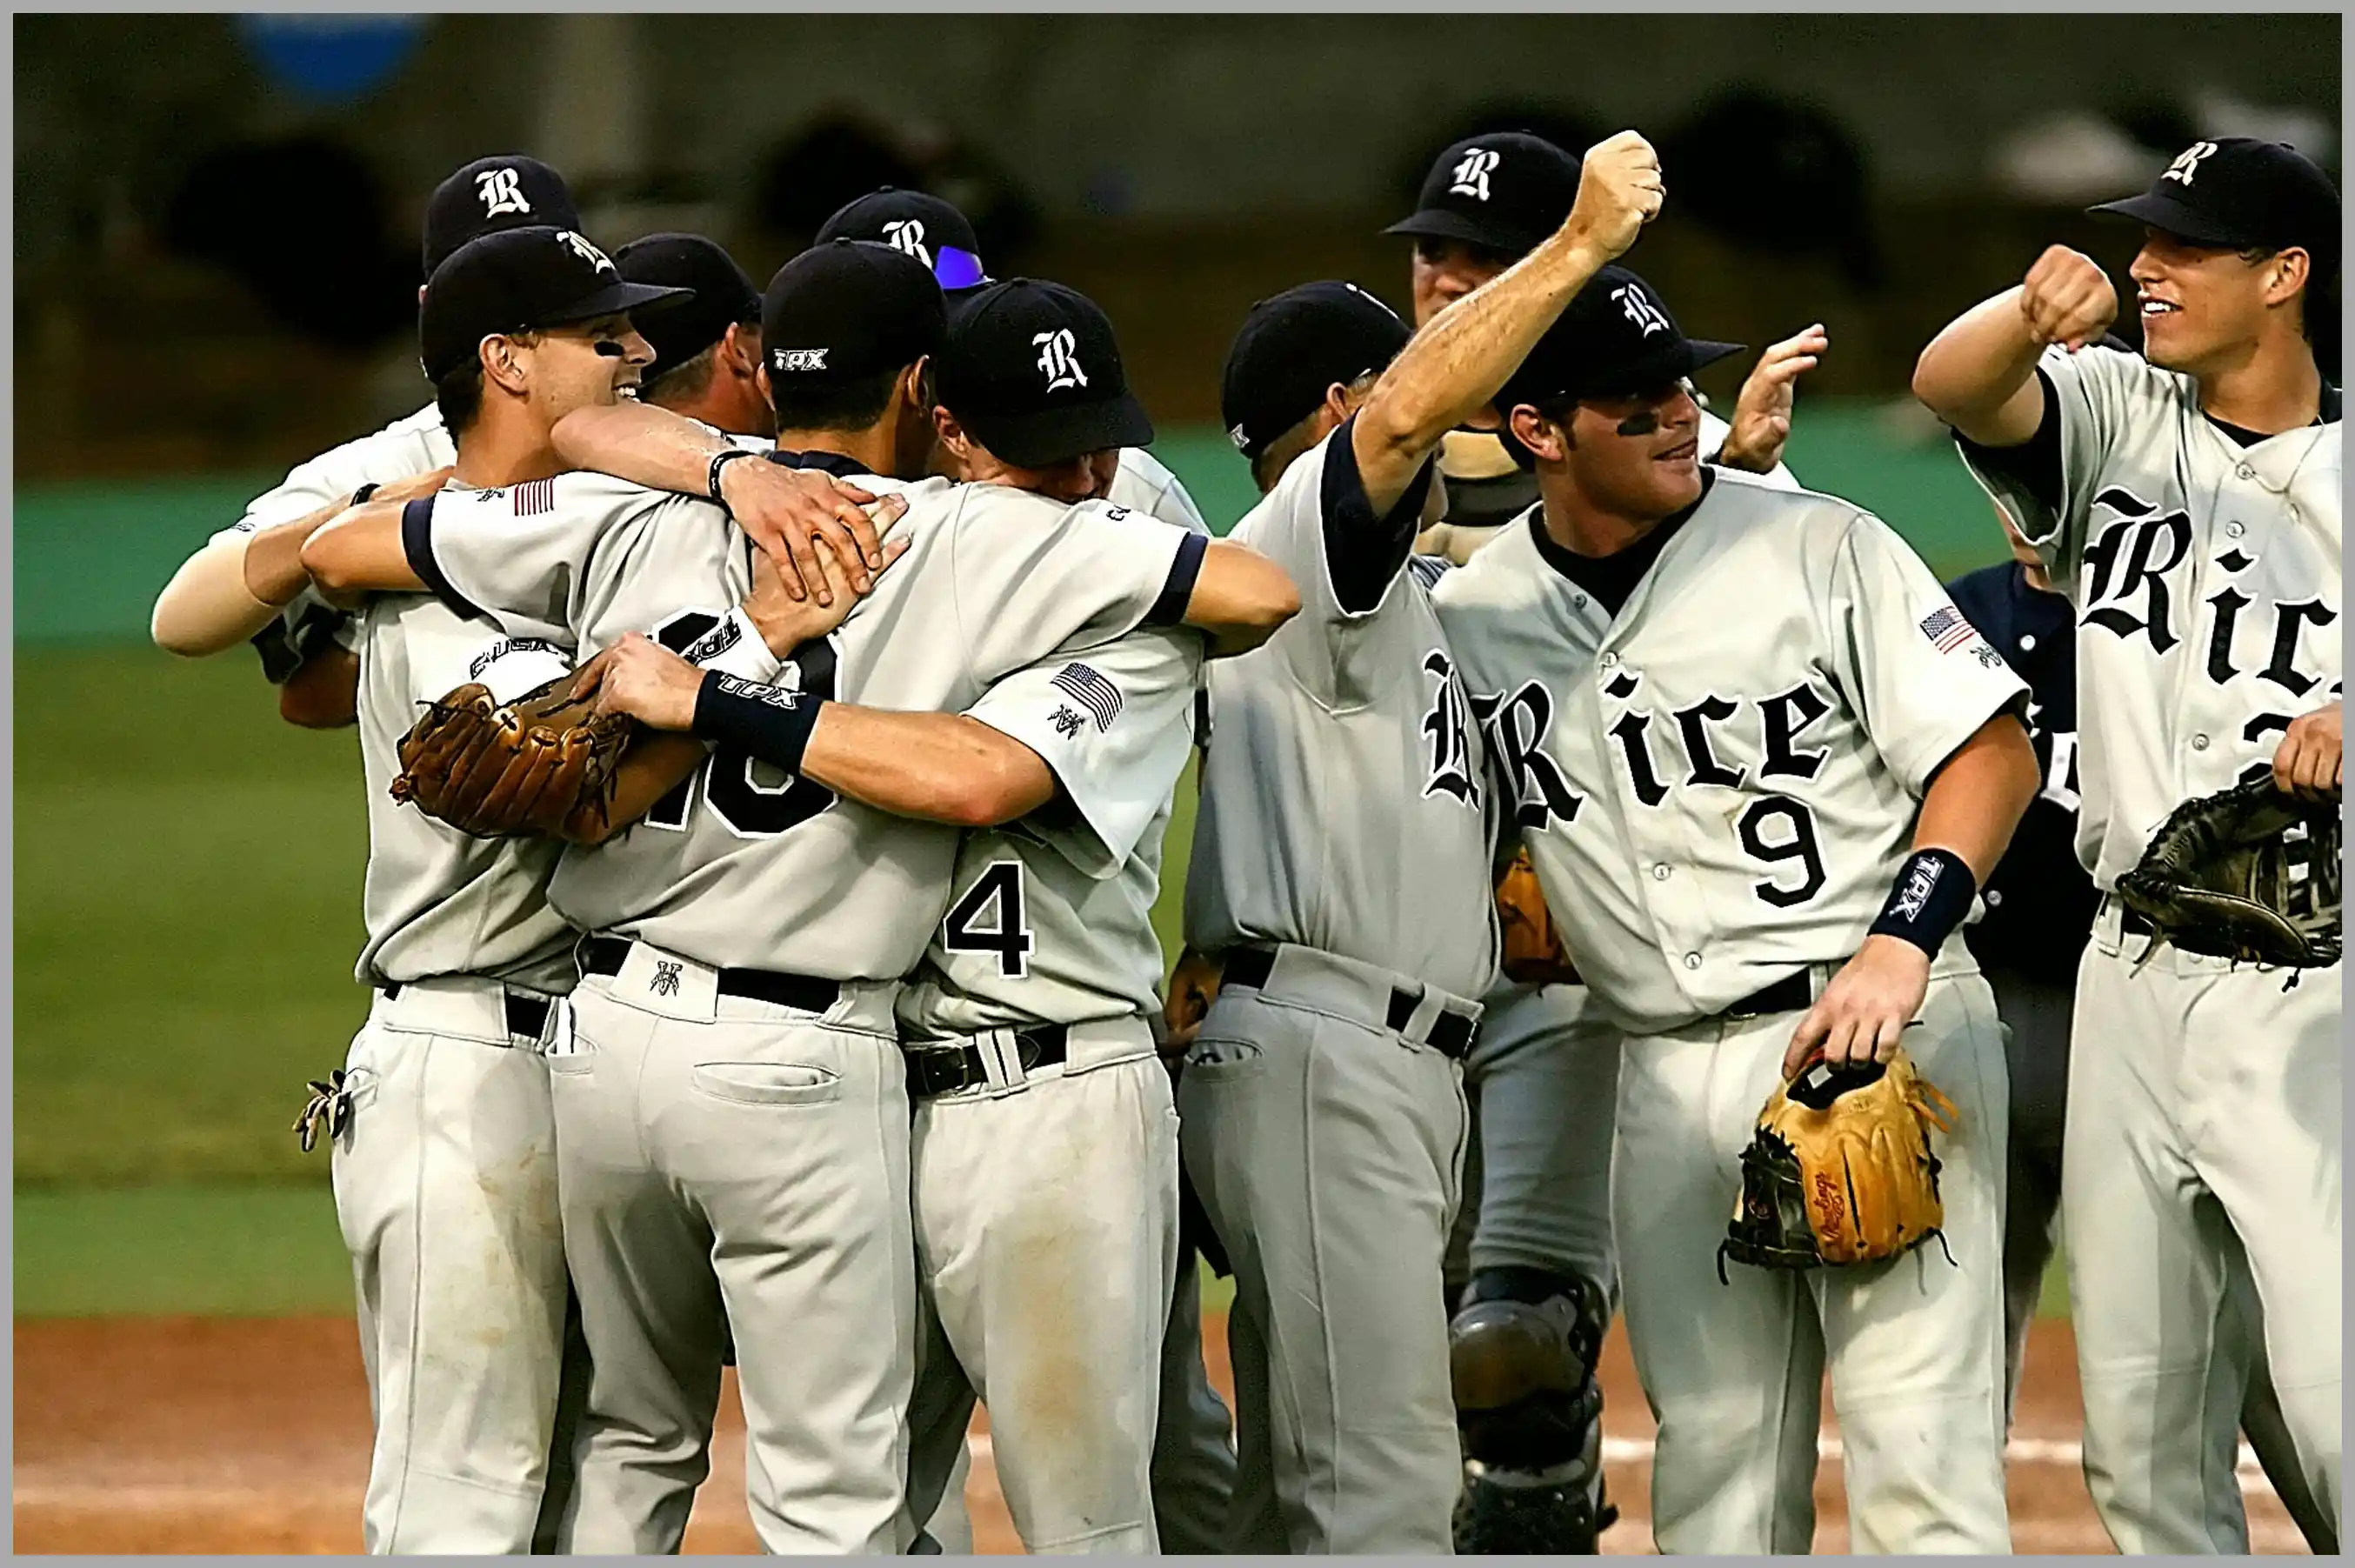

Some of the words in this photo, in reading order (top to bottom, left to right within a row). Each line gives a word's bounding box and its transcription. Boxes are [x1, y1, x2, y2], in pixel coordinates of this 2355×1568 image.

[475, 168, 530, 218] R
[1450, 148, 1500, 201] R
[2161, 141, 2218, 186] R
[1611, 283, 1670, 338] R
[774, 348, 829, 371] TPX
[1032, 328, 1088, 393] R
[2078, 484, 2342, 699] Ric
[717, 672, 807, 711] TPX
[1468, 667, 1837, 831] Rice
[1736, 793, 1829, 909] 9
[943, 859, 1037, 979] 4
[1888, 856, 1945, 924] TPX
